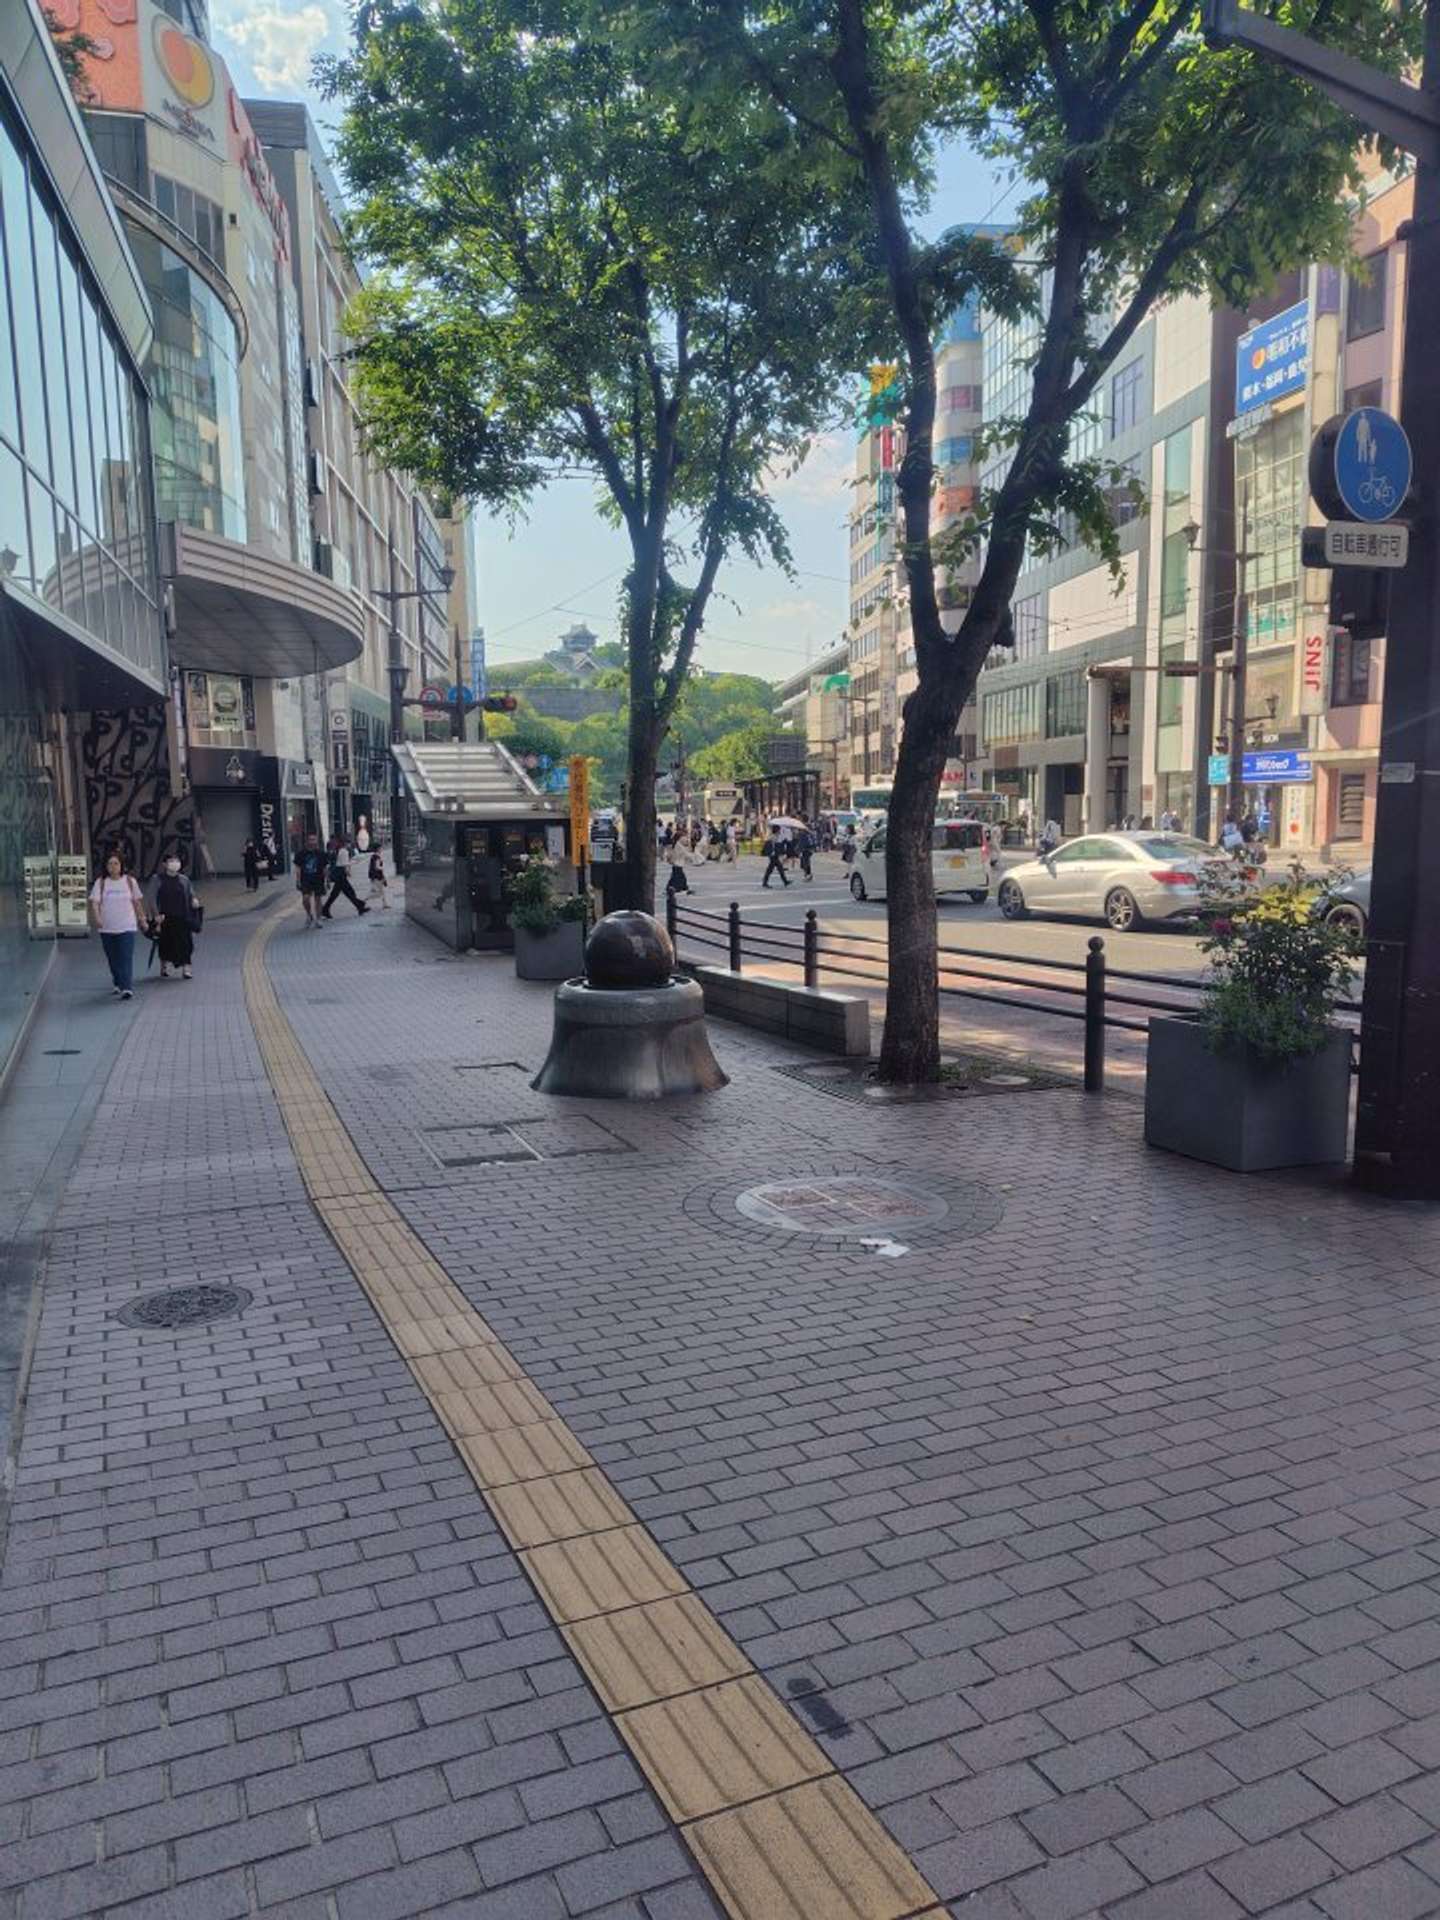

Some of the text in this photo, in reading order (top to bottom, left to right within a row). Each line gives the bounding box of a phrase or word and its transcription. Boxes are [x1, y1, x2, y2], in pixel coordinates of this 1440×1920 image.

[1331, 533, 1401, 558] 自転車通行可
[1304, 635, 1323, 692] JINS
